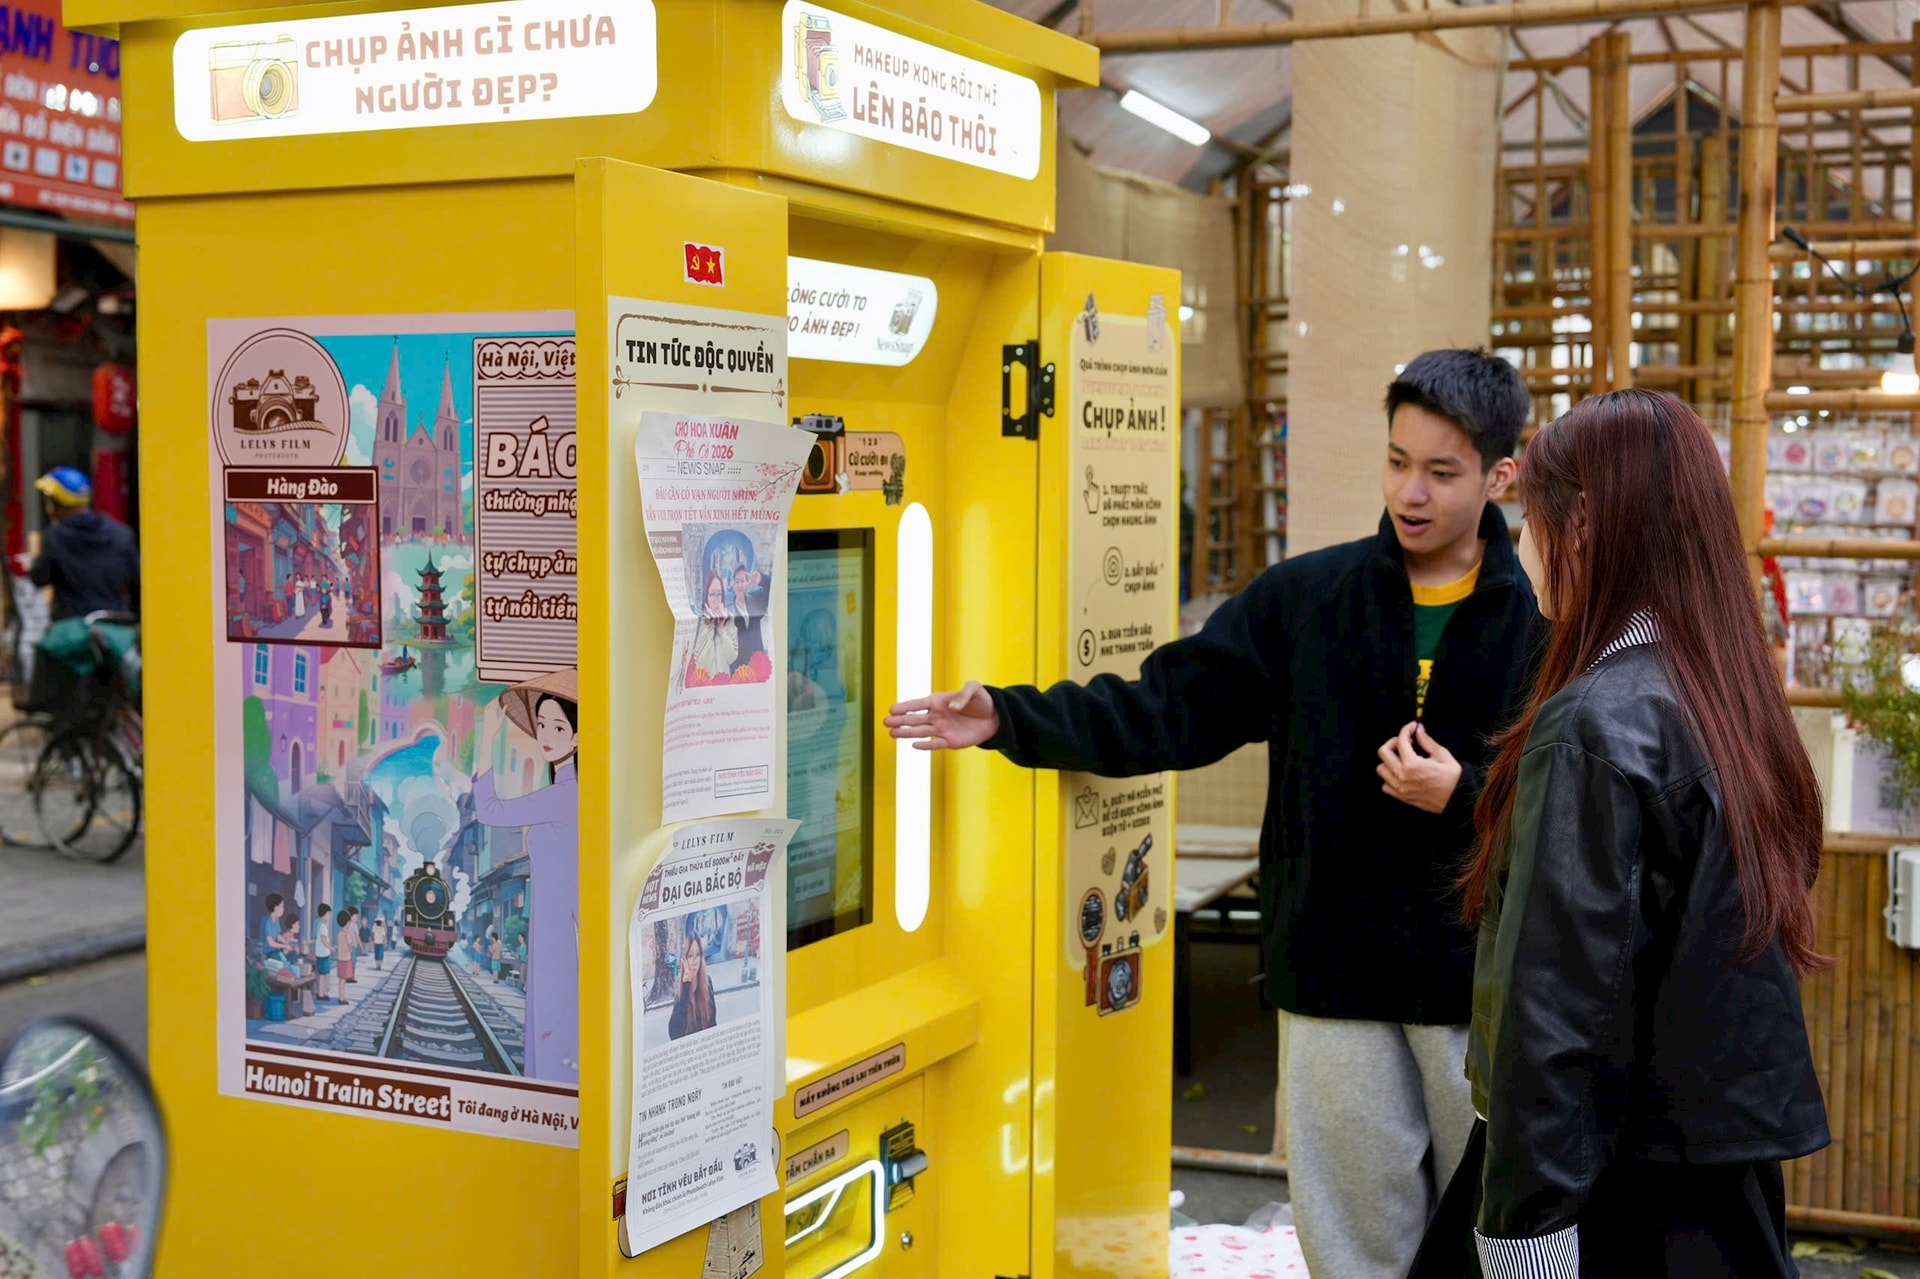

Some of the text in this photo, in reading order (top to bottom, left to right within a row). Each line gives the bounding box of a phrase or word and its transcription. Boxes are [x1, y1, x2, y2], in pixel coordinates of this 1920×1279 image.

[305, 14, 617, 74] CHỤP ẢNH GÌ CHƯA
[854, 43, 998, 107] MAKEUP XONG RỒI THÌ
[355, 72, 559, 114] NGƯỜI ĐẸP?
[853, 80, 997, 157] LÊN BÁO THÔI
[819, 288, 850, 309] CƯỜI
[852, 295, 867, 311] TO
[801, 311, 829, 335] ẢNH
[830, 320, 861, 341] ĐẸP!
[481, 349, 576, 371] Hà Nội, Việt
[626, 337, 774, 375] TIN TỨC ĐỘC QUYỀN
[675, 421, 740, 440] CHỢ HOA XUÂN
[1082, 397, 1166, 438] CHỤP ẢNH!
[240, 438, 311, 449] LELYS FILM
[712, 444, 735, 459] 2026
[677, 461, 726, 475] NEWS SNAP
[267, 477, 338, 499] Hàng Đào
[484, 488, 547, 517] thường
[684, 507, 697, 521] TẾT
[713, 509, 730, 521] XINH
[732, 507, 749, 521] HẾT
[484, 550, 577, 579] tự chụp ản
[485, 590, 577, 622] tự nổi tiến
[682, 836, 706, 850] LELYS
[709, 832, 734, 844] FILM
[664, 866, 679, 878] THIẾU
[679, 865, 688, 874] GIA
[689, 862, 703, 873] THỪA
[704, 858, 712, 870] KẾ
[641, 893, 658, 905] NEWS
[644, 880, 659, 895] HOT
[662, 867, 742, 905] ĐẠI GIA BẮC BỘ
[245, 1064, 450, 1117] Hanoi Train Street
[457, 1099, 476, 1115] Tôi
[478, 1102, 508, 1123] đang
[510, 1106, 520, 1121] ở
[520, 1109, 540, 1124] Hà
[542, 1111, 567, 1131] Nội,
[639, 1111, 648, 1124] TIN
[647, 1102, 667, 1120] NHANH
[668, 1094, 686, 1112] TRONG
[641, 1189, 656, 1205] NƠI
[657, 1182, 677, 1197] TÌNH
[678, 1173, 692, 1189] YÊU
[694, 1163, 708, 1182] BẮT
